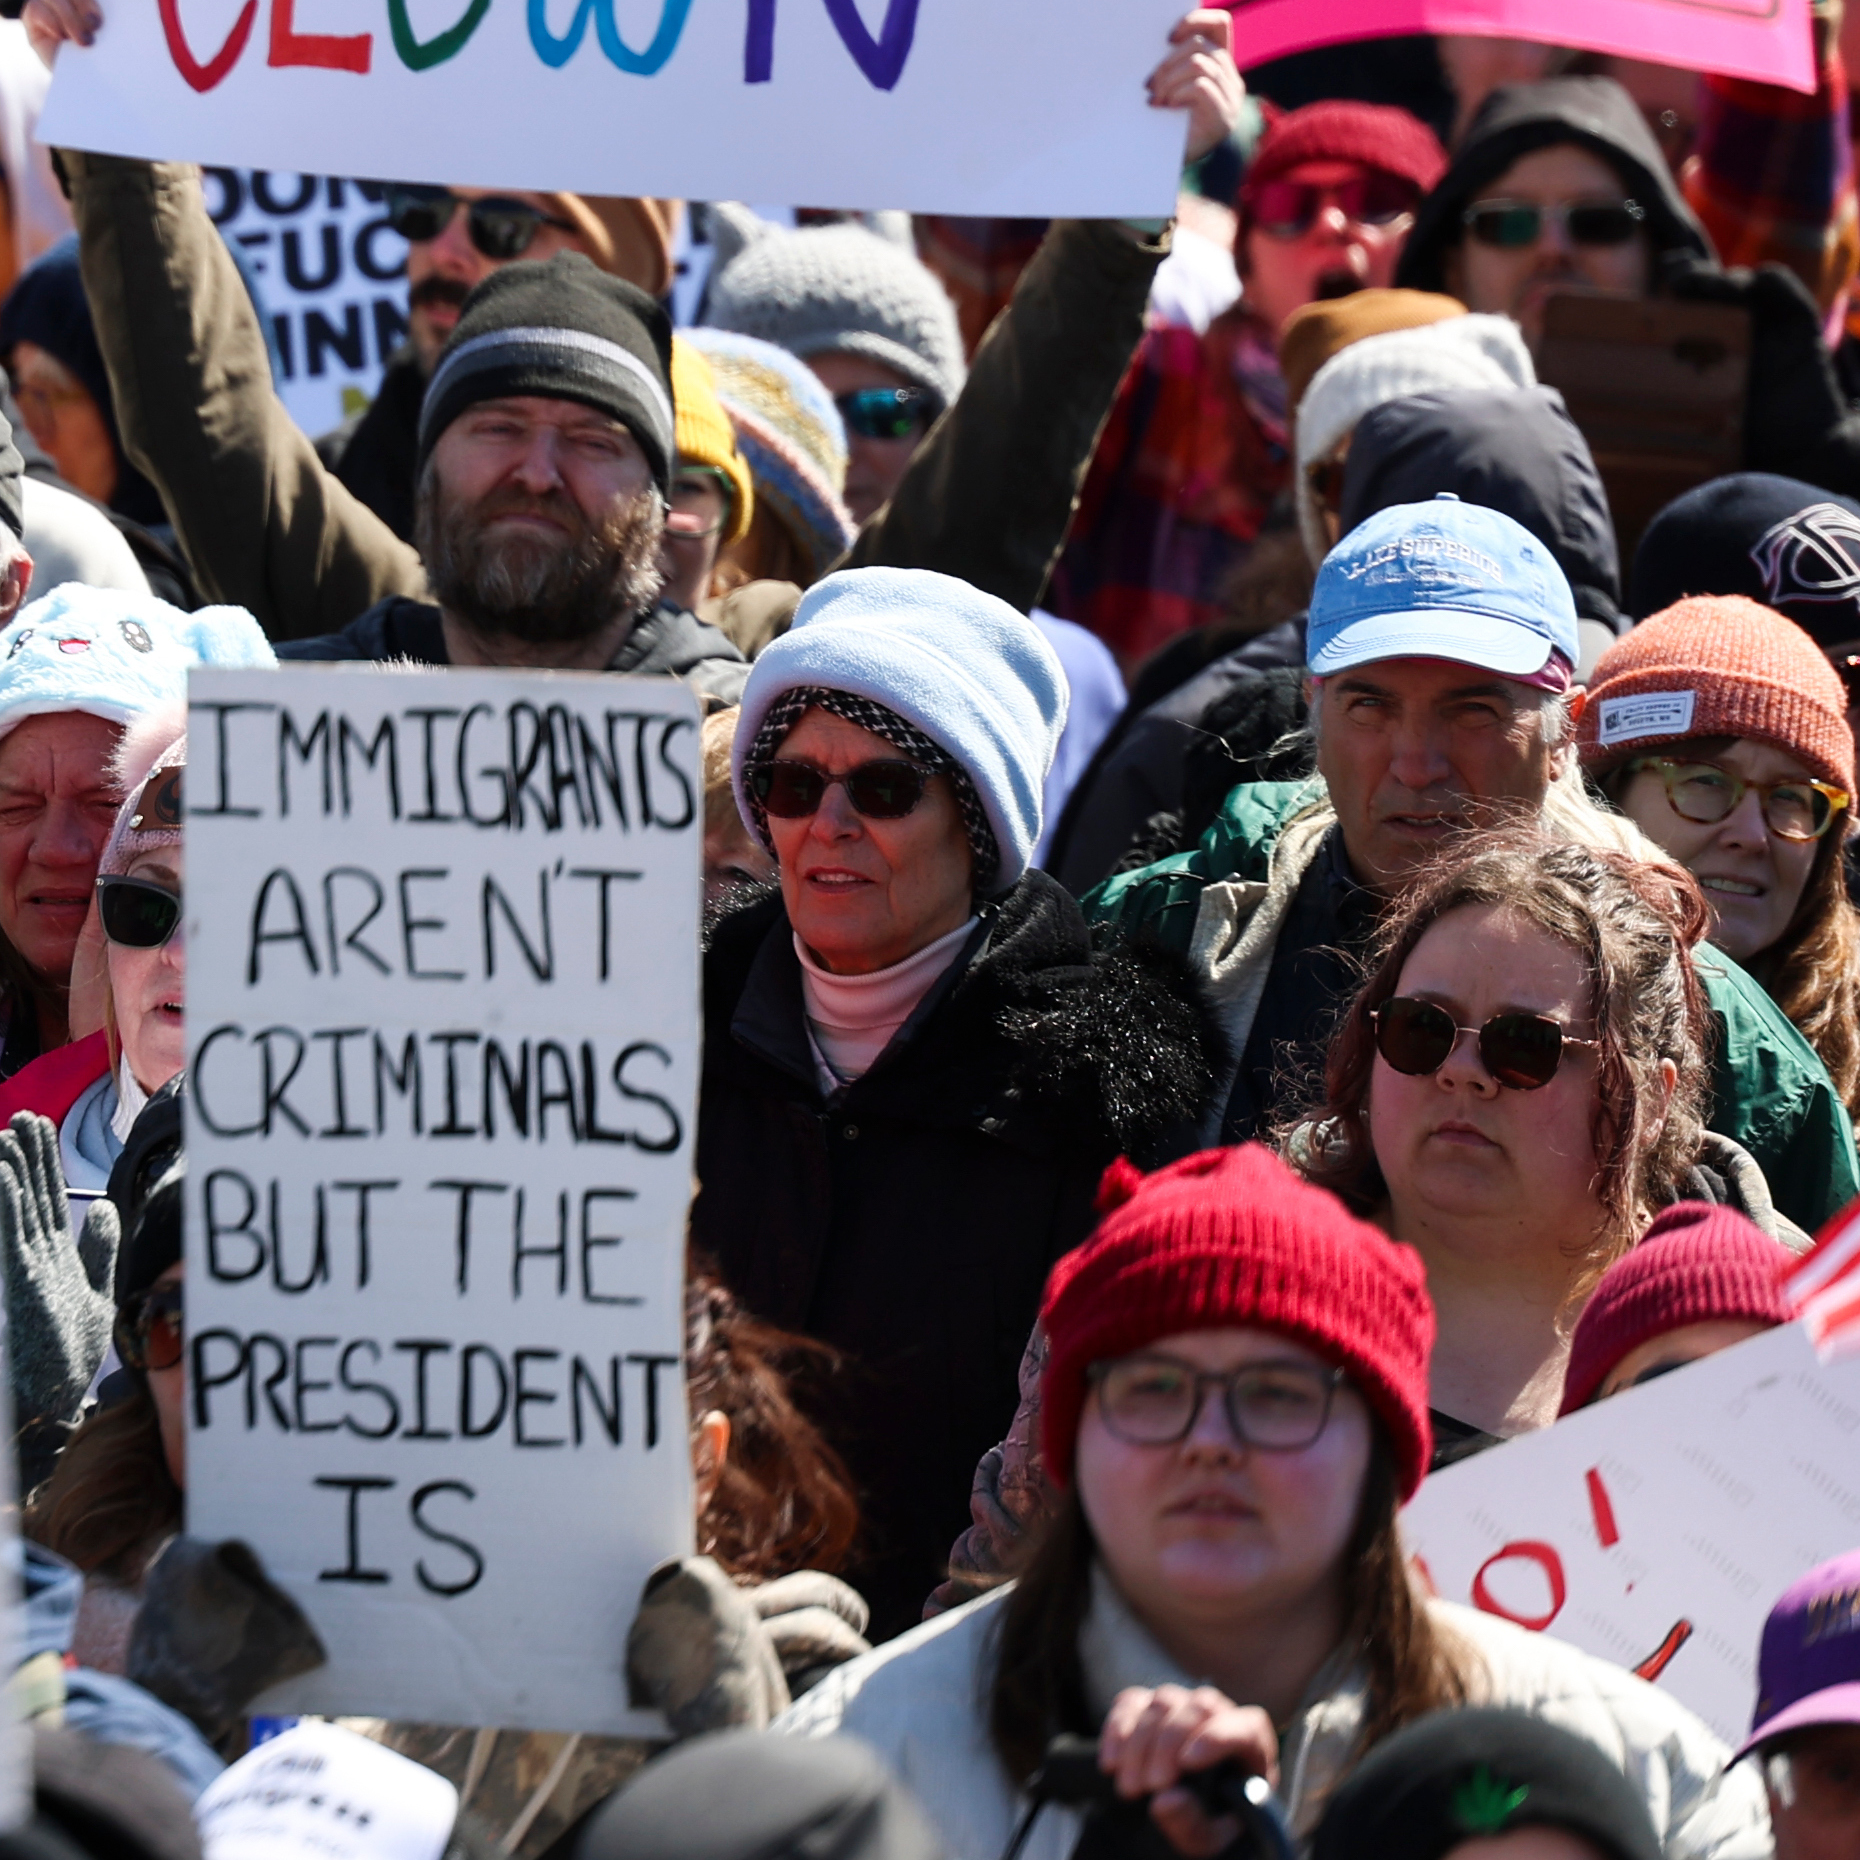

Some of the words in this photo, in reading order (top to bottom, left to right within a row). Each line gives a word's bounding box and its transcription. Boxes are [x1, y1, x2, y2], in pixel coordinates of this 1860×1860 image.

[187, 701, 696, 833] IMMIGRANTS
[247, 857, 643, 986] AREN'T
[192, 1023, 684, 1154] CRIMINALS
[205, 1169, 400, 1293] BUT
[429, 1180, 646, 1306] THE
[191, 1329, 679, 1451] PRESIDENT
[312, 1476, 485, 1598] IS
